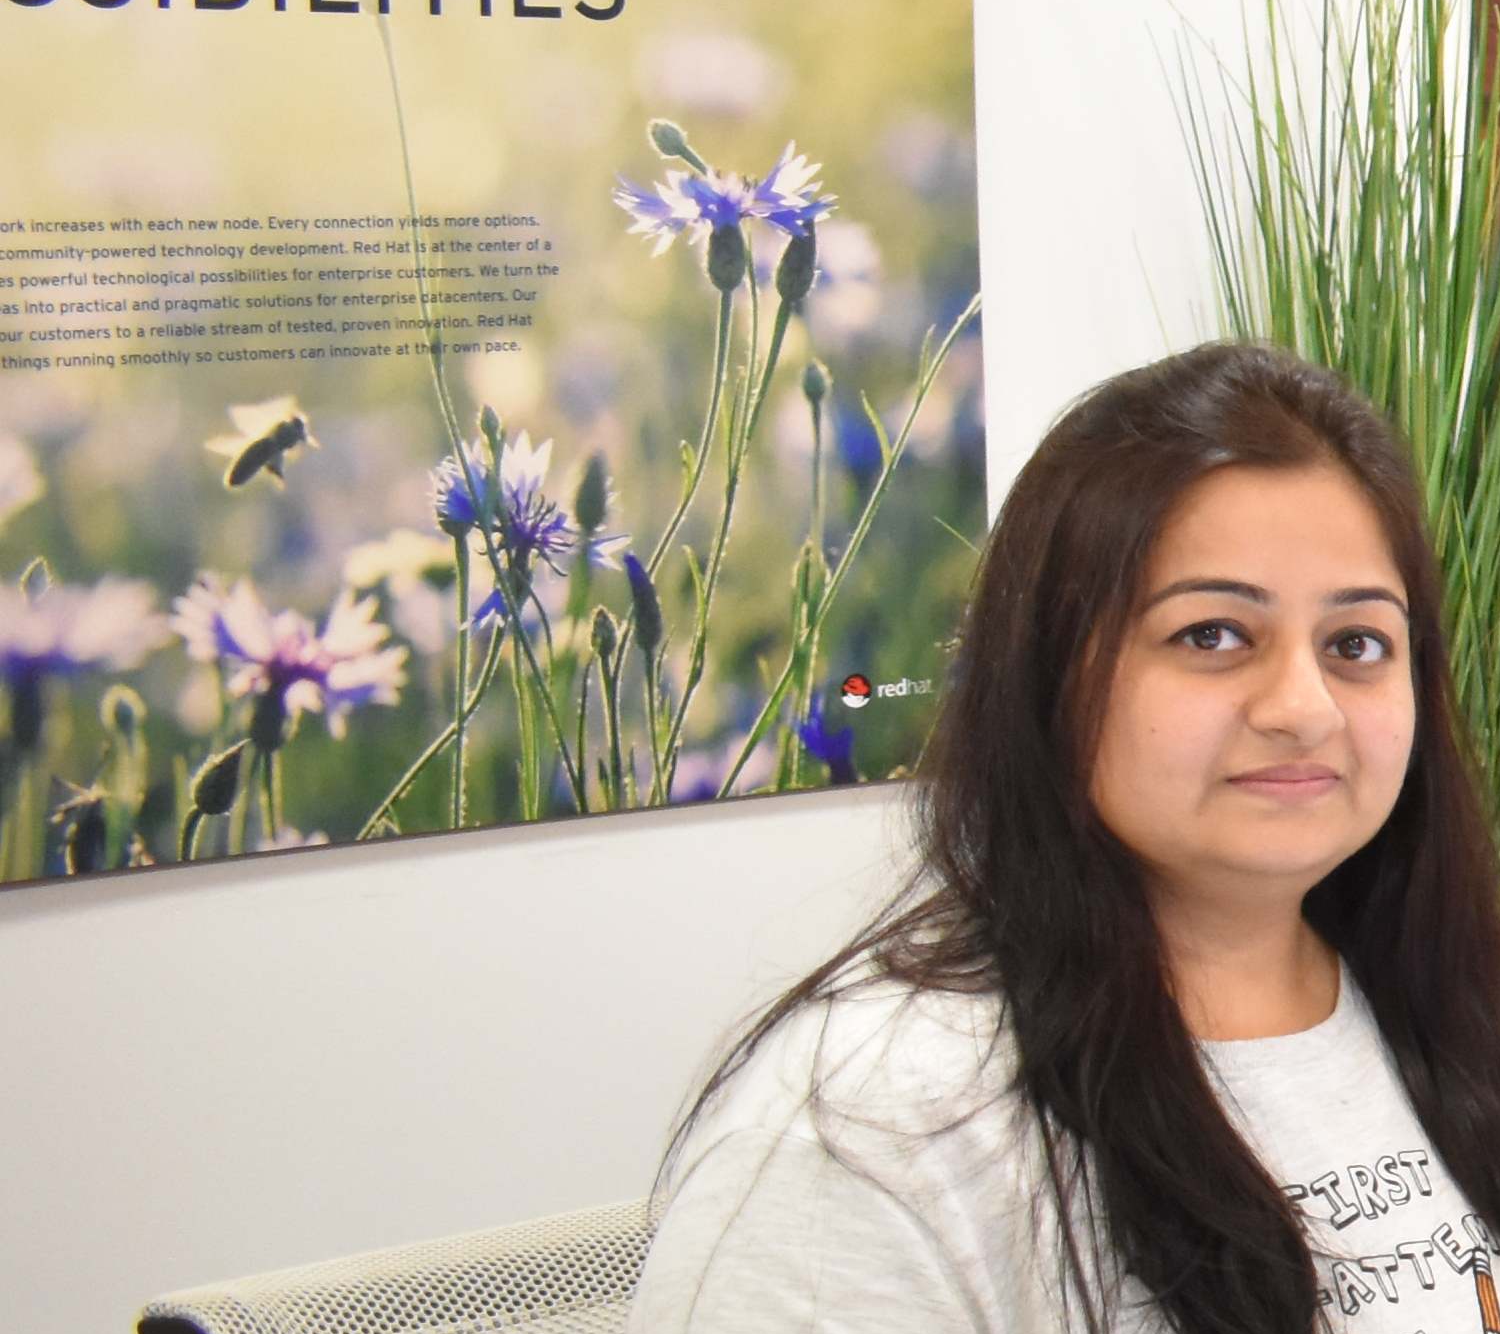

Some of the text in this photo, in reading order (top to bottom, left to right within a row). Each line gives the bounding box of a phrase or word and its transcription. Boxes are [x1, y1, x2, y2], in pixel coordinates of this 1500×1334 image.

[31, 218, 105, 233] increases
[110, 217, 143, 231] with
[148, 216, 183, 230] each
[188, 218, 218, 230] new
[268, 216, 309, 232] Every
[314, 215, 394, 229] connection
[399, 215, 440, 230] yields
[444, 217, 480, 228] more
[161, 243, 244, 260] technology
[353, 241, 381, 254] Red
[386, 241, 410, 253] Hat
[431, 240, 446, 252] at
[450, 239, 473, 252] the
[477, 240, 521, 251] center
[526, 238, 540, 251] of
[20, 272, 88, 291] powerful
[93, 271, 195, 287] technological
[200, 269, 288, 286] possibilities
[293, 268, 312, 281] for
[318, 267, 392, 282] enterprise
[479, 265, 500, 277] We
[504, 265, 533, 277] turn
[537, 264, 560, 276] the
[0, 304, 19, 316] as
[24, 301, 55, 314] into
[60, 299, 127, 315] practical
[132, 298, 160, 311] and
[164, 296, 240, 313] pragmatic
[246, 294, 312, 309] solutions
[317, 293, 337, 306] for
[342, 291, 416, 307] enterprise
[512, 289, 537, 302] Our
[29, 327, 111, 342] customers
[116, 326, 131, 339] to
[136, 328, 145, 338] a
[150, 324, 206, 338] reliable
[211, 322, 263, 336] stream
[268, 321, 282, 334] of
[342, 318, 390, 334] proven
[477, 315, 504, 328] Red
[509, 314, 533, 327] Hat
[1, 356, 50, 372] things
[56, 353, 115, 370] running
[120, 350, 190, 366] smoothly
[195, 351, 213, 363] so
[217, 347, 295, 362] customers
[300, 347, 325, 359] can
[330, 344, 391, 357] innovate
[396, 343, 410, 355] at
[452, 342, 480, 354] own
